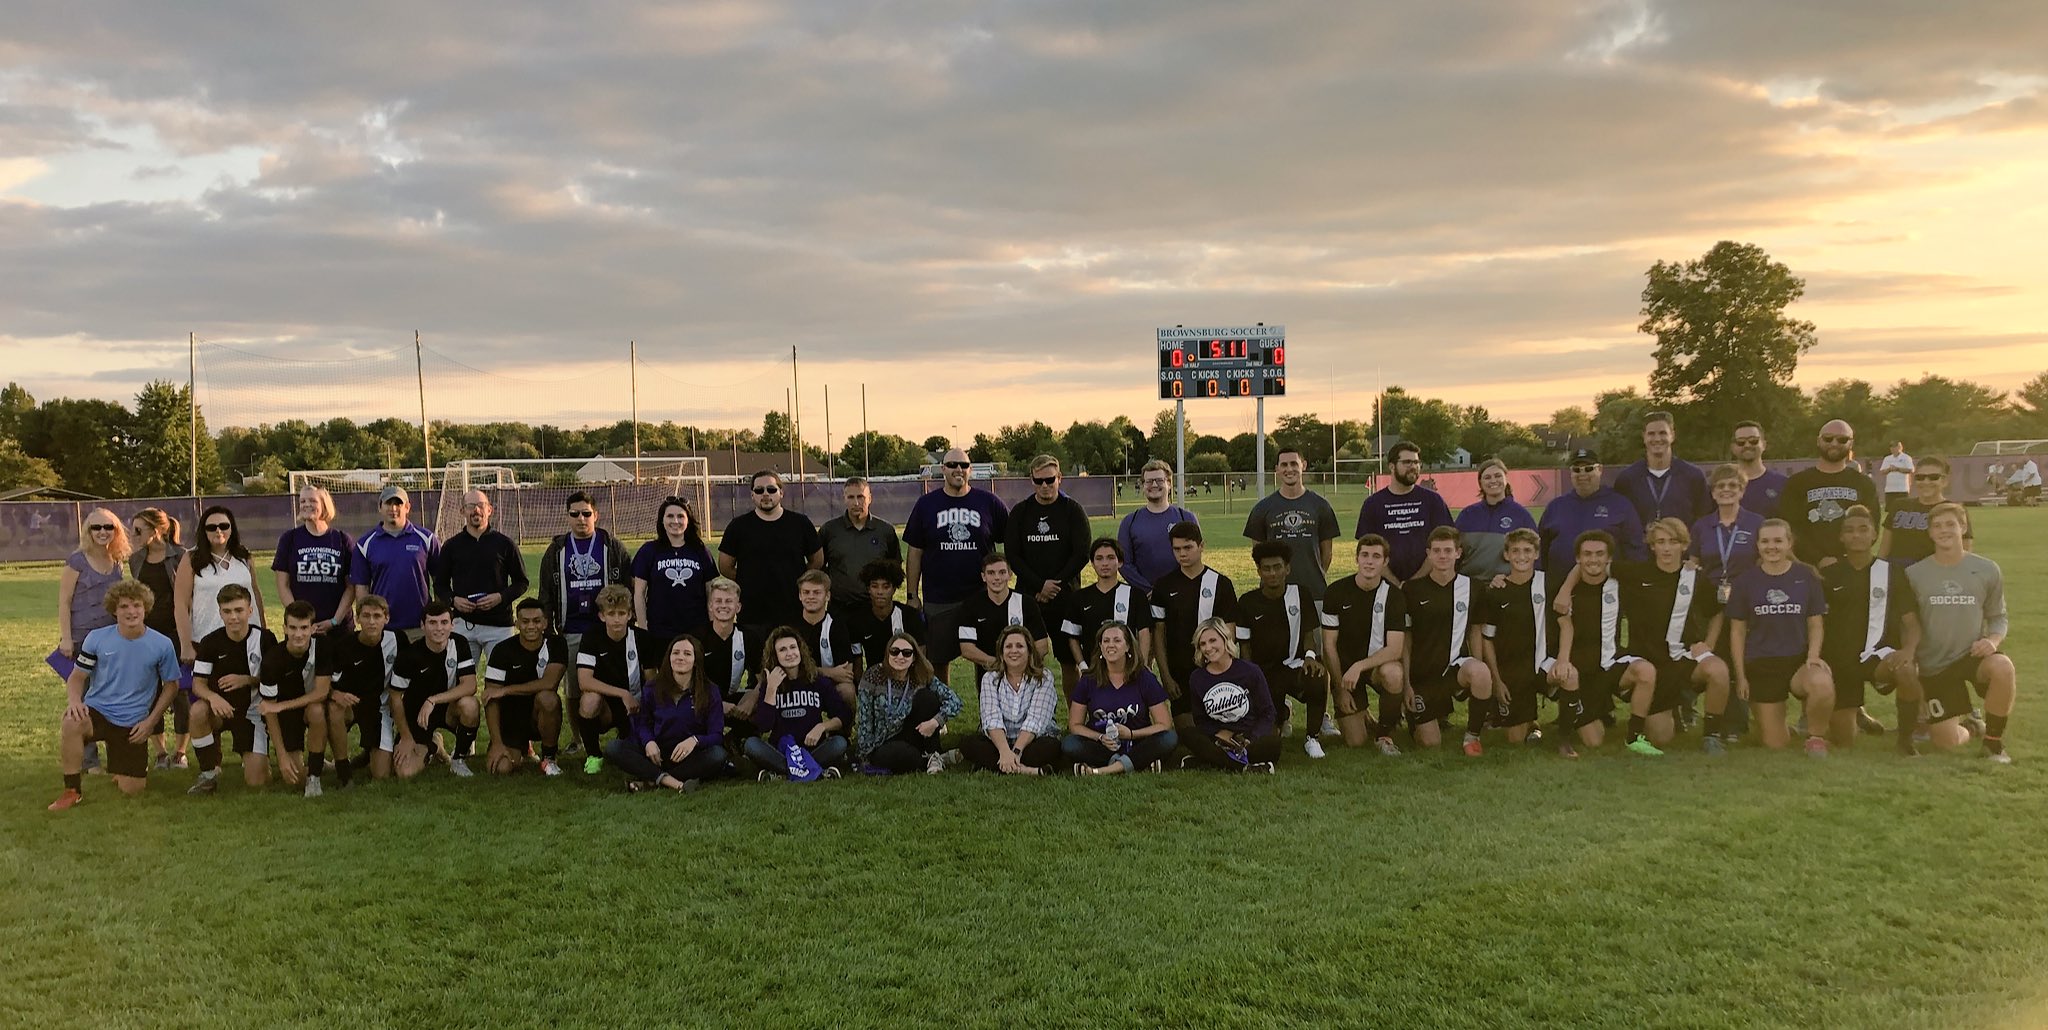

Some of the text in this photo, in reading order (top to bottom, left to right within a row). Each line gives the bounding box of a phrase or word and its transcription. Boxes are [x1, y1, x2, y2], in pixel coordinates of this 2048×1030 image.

[1160, 327, 1267, 338] BROWNSBURG SOCCER
[1160, 341, 1184, 350] HOME
[1259, 338, 1283, 348] GUEST
[1172, 349, 1182, 367] 0
[1274, 347, 1284, 365] 0
[1161, 371, 1183, 380] S.O.G.
[1191, 370, 1220, 379] C KICKS
[1226, 369, 1254, 378] C KICKS
[1262, 369, 1285, 377] S.O.G.
[1173, 380, 1182, 397] 0
[1207, 379, 1218, 396] 0
[1239, 378, 1250, 395] 0
[1807, 487, 1857, 502] BROWNSBURG
[936, 507, 982, 529] DOGS
[1388, 508, 1419, 516] LITERALLY
[1893, 510, 1930, 530] DOG
[1027, 534, 1059, 543] FOOTBALL
[297, 547, 341, 557] BROWNSBURG
[940, 542, 977, 551] FOOTBALL
[297, 562, 341, 576] EAST
[657, 558, 700, 571] BROWNSBURG
[1930, 596, 1976, 605] SOCCER
[1754, 603, 1801, 616] SOCCER
[776, 690, 820, 709] LLDOGS
[1203, 689, 1249, 714] Bulldogs
